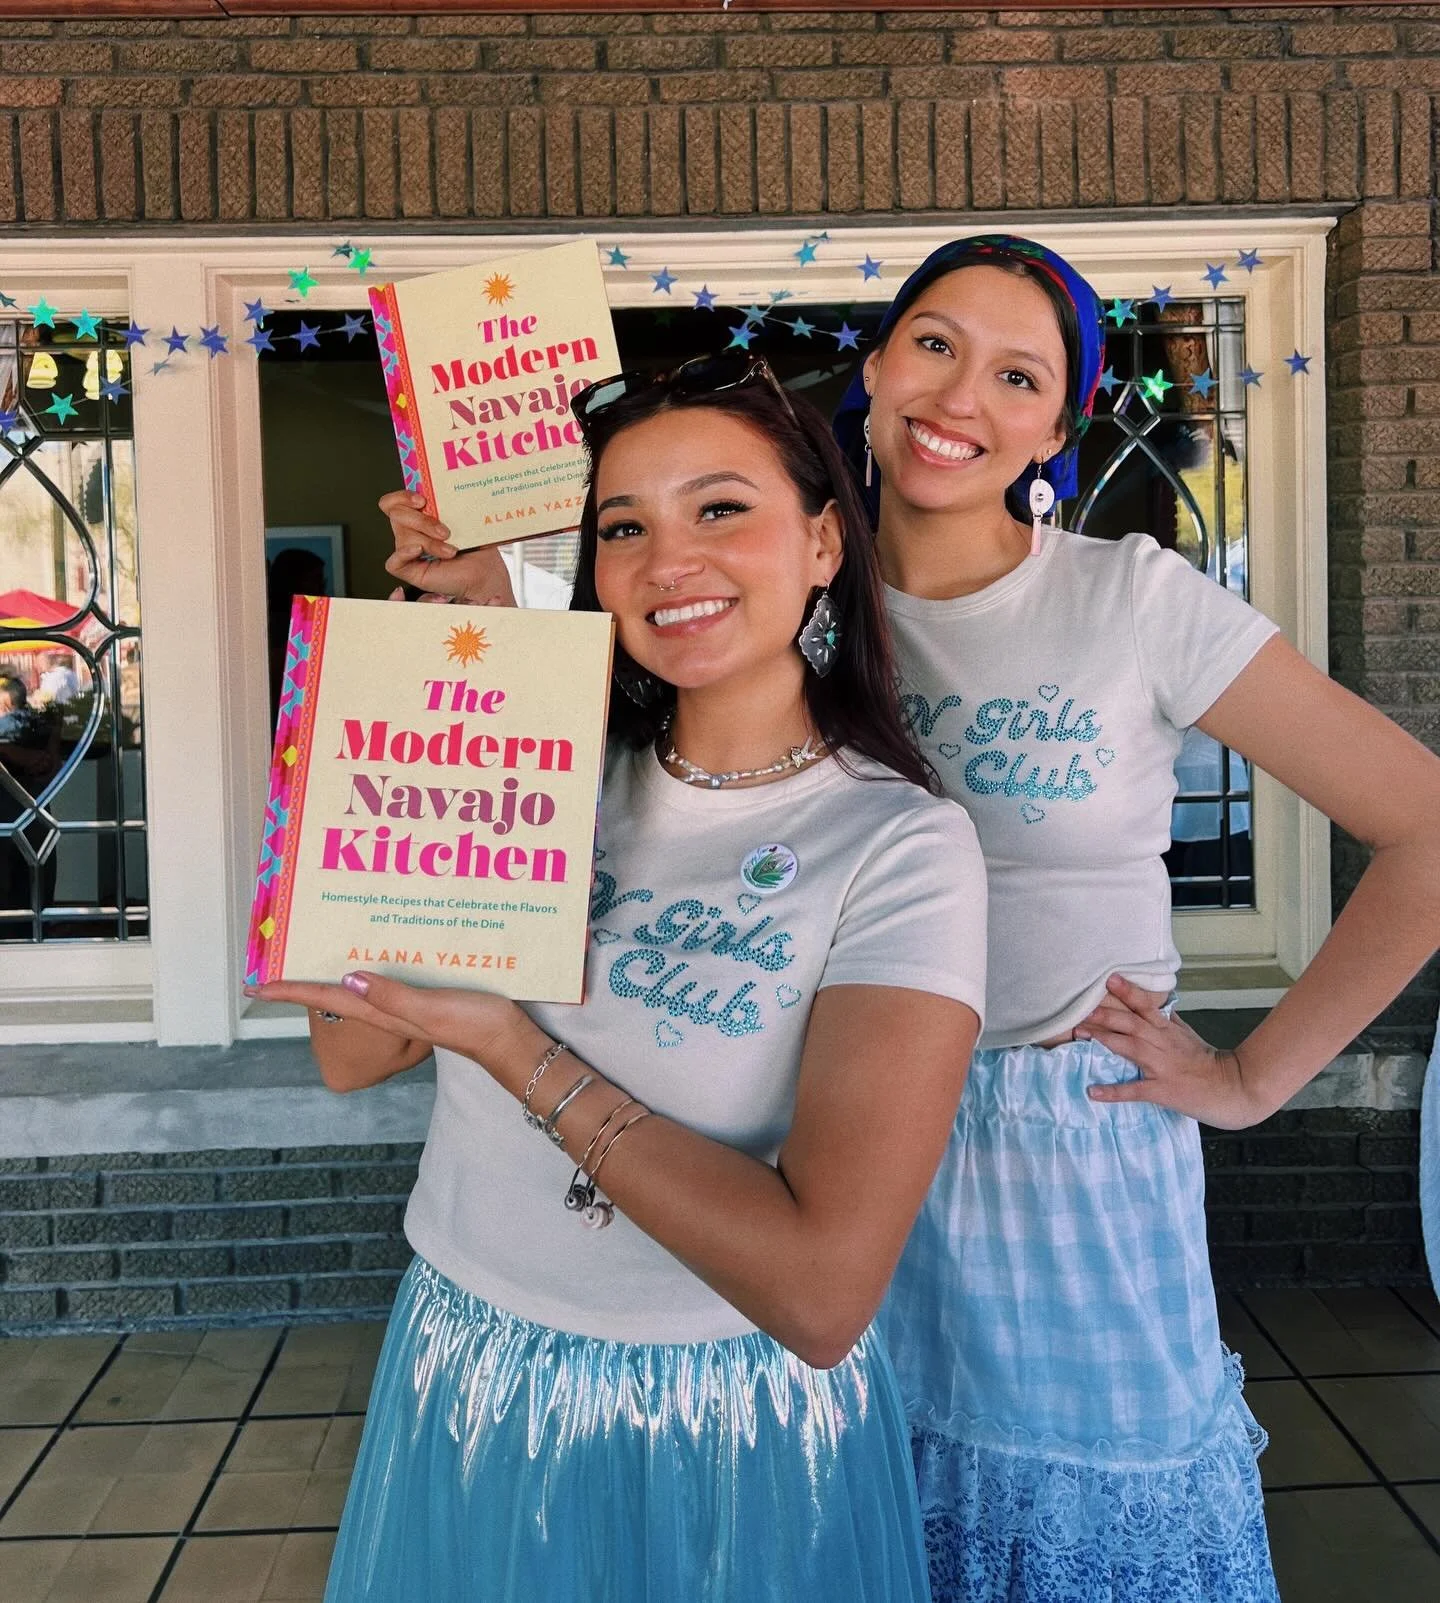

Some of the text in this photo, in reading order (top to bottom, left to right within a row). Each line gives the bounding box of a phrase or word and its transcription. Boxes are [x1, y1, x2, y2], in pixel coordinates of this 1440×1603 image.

[478, 314, 538, 344] The
[431, 337, 599, 394] Modern
[441, 417, 583, 471] Kitche
[454, 474, 493, 491] Homestyle
[494, 472, 523, 483] Recipes
[524, 467, 539, 477] that
[540, 461, 576, 473] Celebrate
[491, 487, 505, 496] and
[506, 480, 542, 493] Traditions
[553, 475, 566, 483] the
[484, 496, 583, 525] ALANA YAZZ
[423, 679, 507, 715] The
[964, 698, 1103, 745] Girls
[336, 718, 574, 773] Modern
[964, 750, 1098, 801] Club
[344, 773, 556, 836] Navajo
[318, 825, 568, 884] Kitchen
[321, 891, 558, 915] Homestyle Recipes that Celebrate the Flavors
[370, 913, 506, 930] and Traditions of the Diné
[347, 948, 518, 970] ALANA YAZZIE
[633, 899, 796, 972] Girls
[609, 948, 766, 1037] Club
